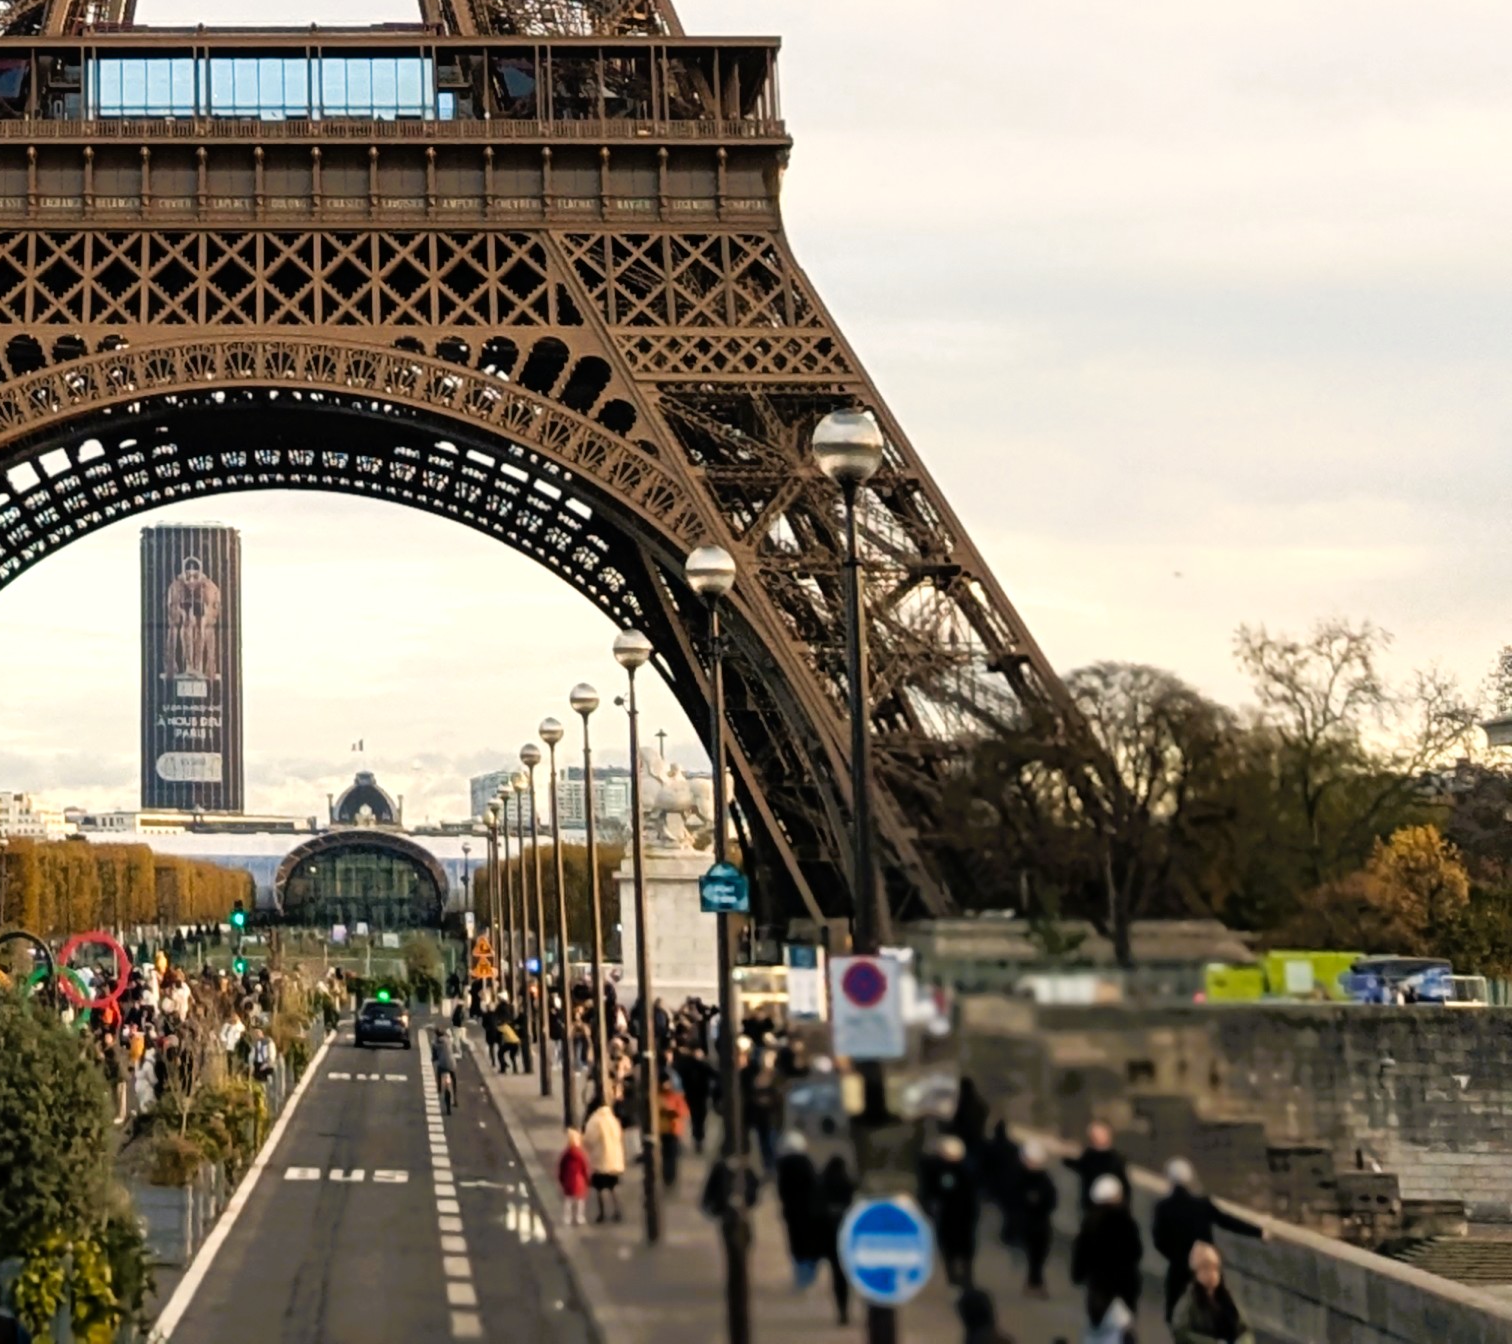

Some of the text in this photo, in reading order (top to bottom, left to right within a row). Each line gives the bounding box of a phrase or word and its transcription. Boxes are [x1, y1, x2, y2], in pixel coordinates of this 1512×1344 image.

[168, 716, 198, 727] NOUS
[199, 716, 222, 727] DEU
[174, 728, 206, 739] PARIS
[284, 1167, 409, 1182] BUS
